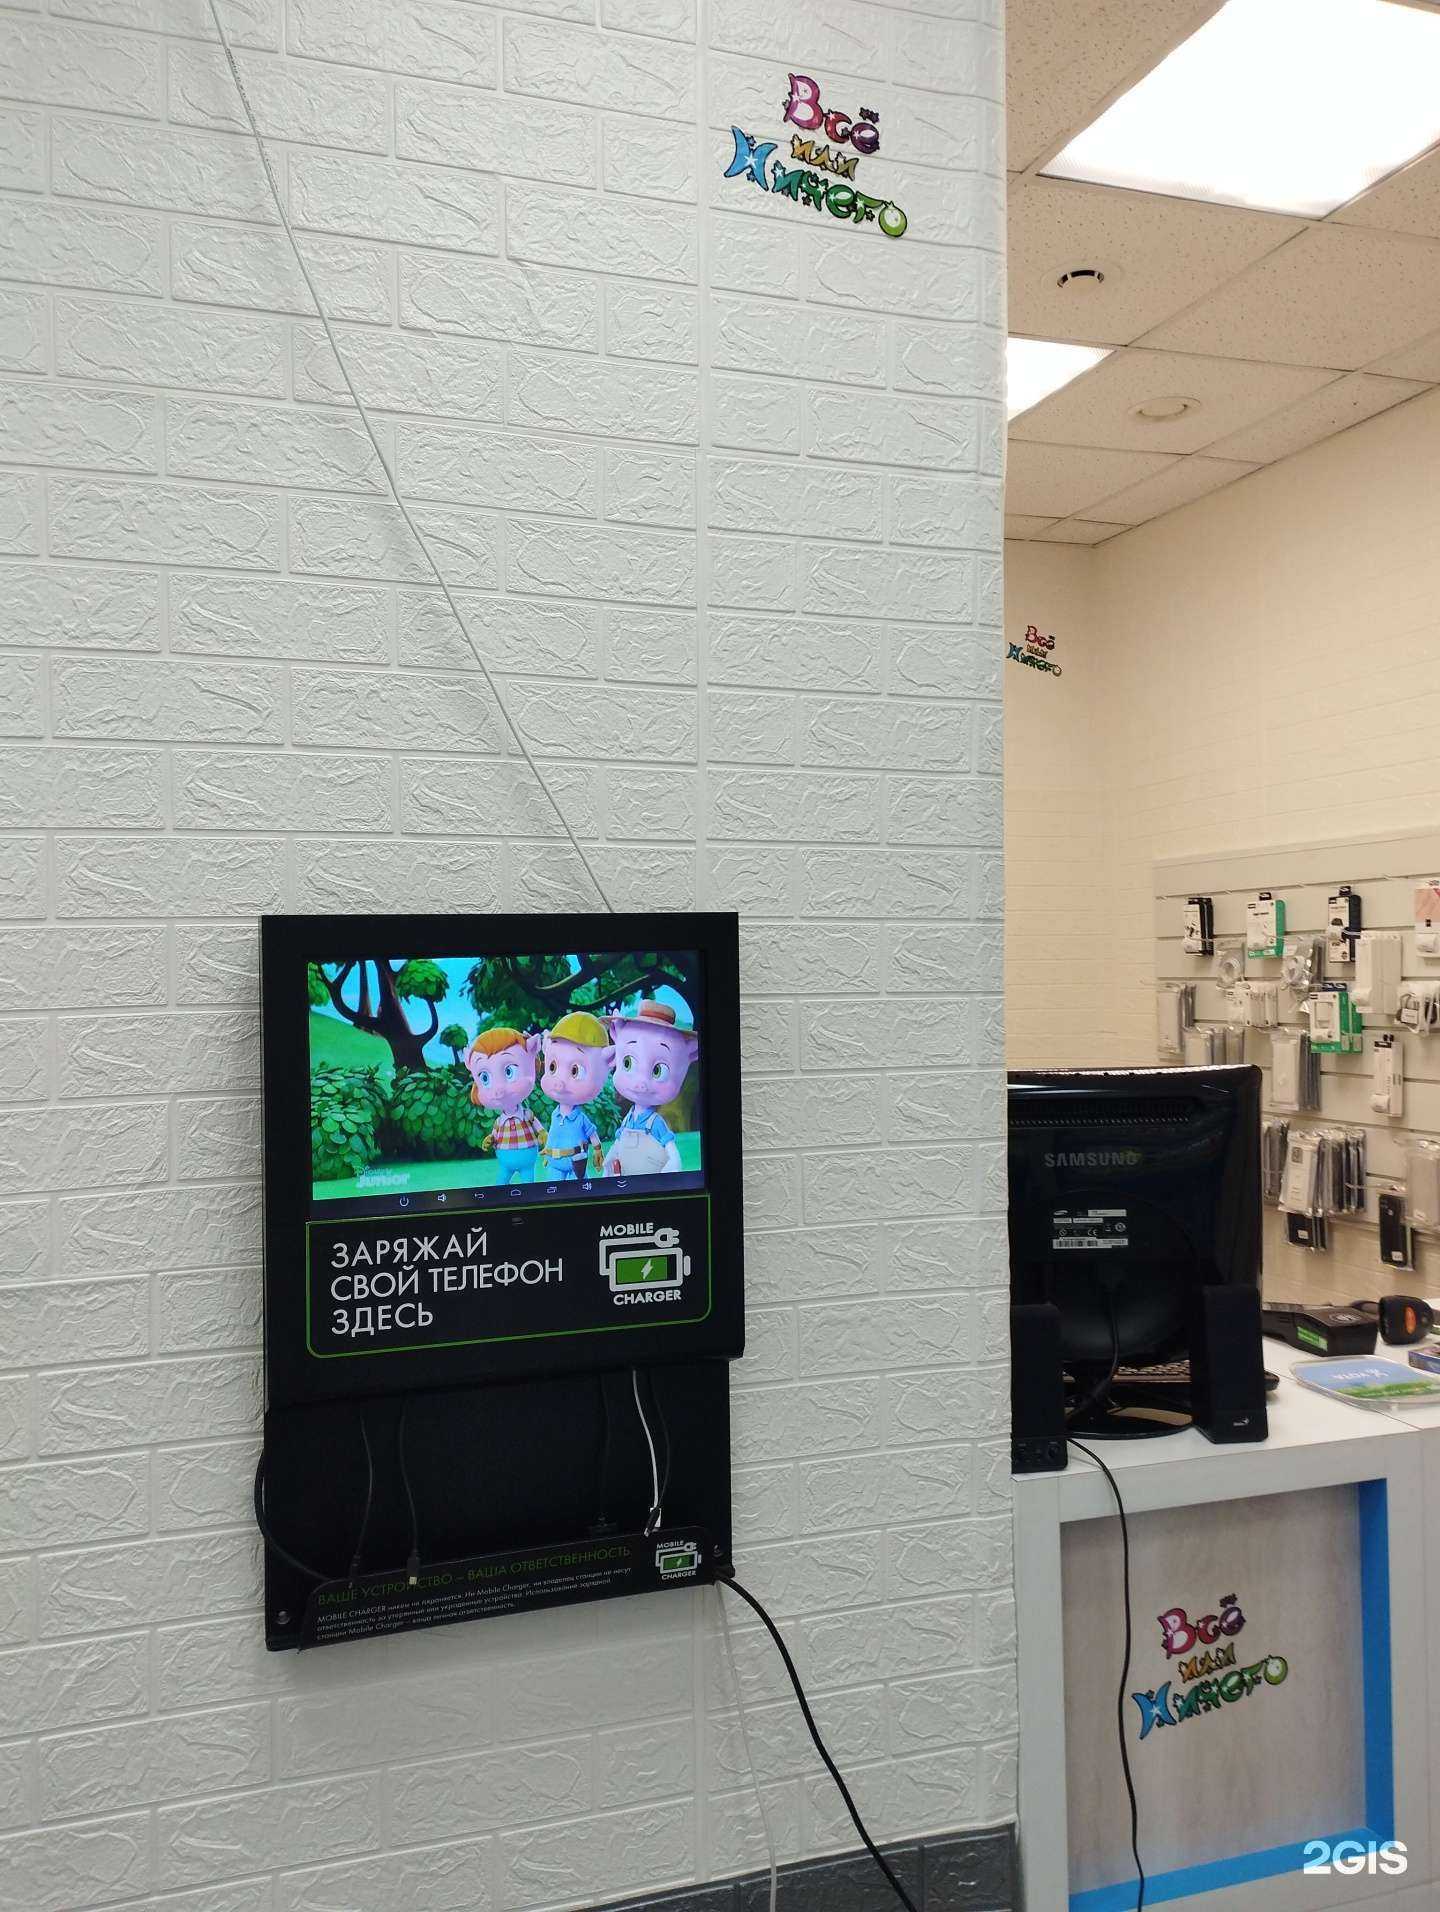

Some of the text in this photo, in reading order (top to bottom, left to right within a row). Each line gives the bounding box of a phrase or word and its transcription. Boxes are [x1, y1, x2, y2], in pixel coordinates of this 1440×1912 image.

[782, 72, 880, 154] Всё
[1044, 1151, 1141, 1167] SAMSUNG
[600, 1222, 654, 1237] MOBILE
[331, 1227, 487, 1268] ЗАРЯЖАЙ
[331, 1258, 563, 1300] СВОЙ ТЕЛЕФОН
[613, 1289, 681, 1305] CHARGER
[331, 1302, 434, 1338] ЗДЕСЬ
[656, 1540, 684, 1549] MOBILE
[318, 1589, 356, 1603] ВАШЕ
[467, 1564, 507, 1581] ВАША
[511, 1545, 631, 1573] ОТВЕТСТВЕННОСТЬ
[661, 1570, 697, 1580] CHARGER
[318, 1611, 346, 1623] MOBILE
[348, 1605, 385, 1618] CHARGER
[1157, 1593, 1246, 1659] Всё
